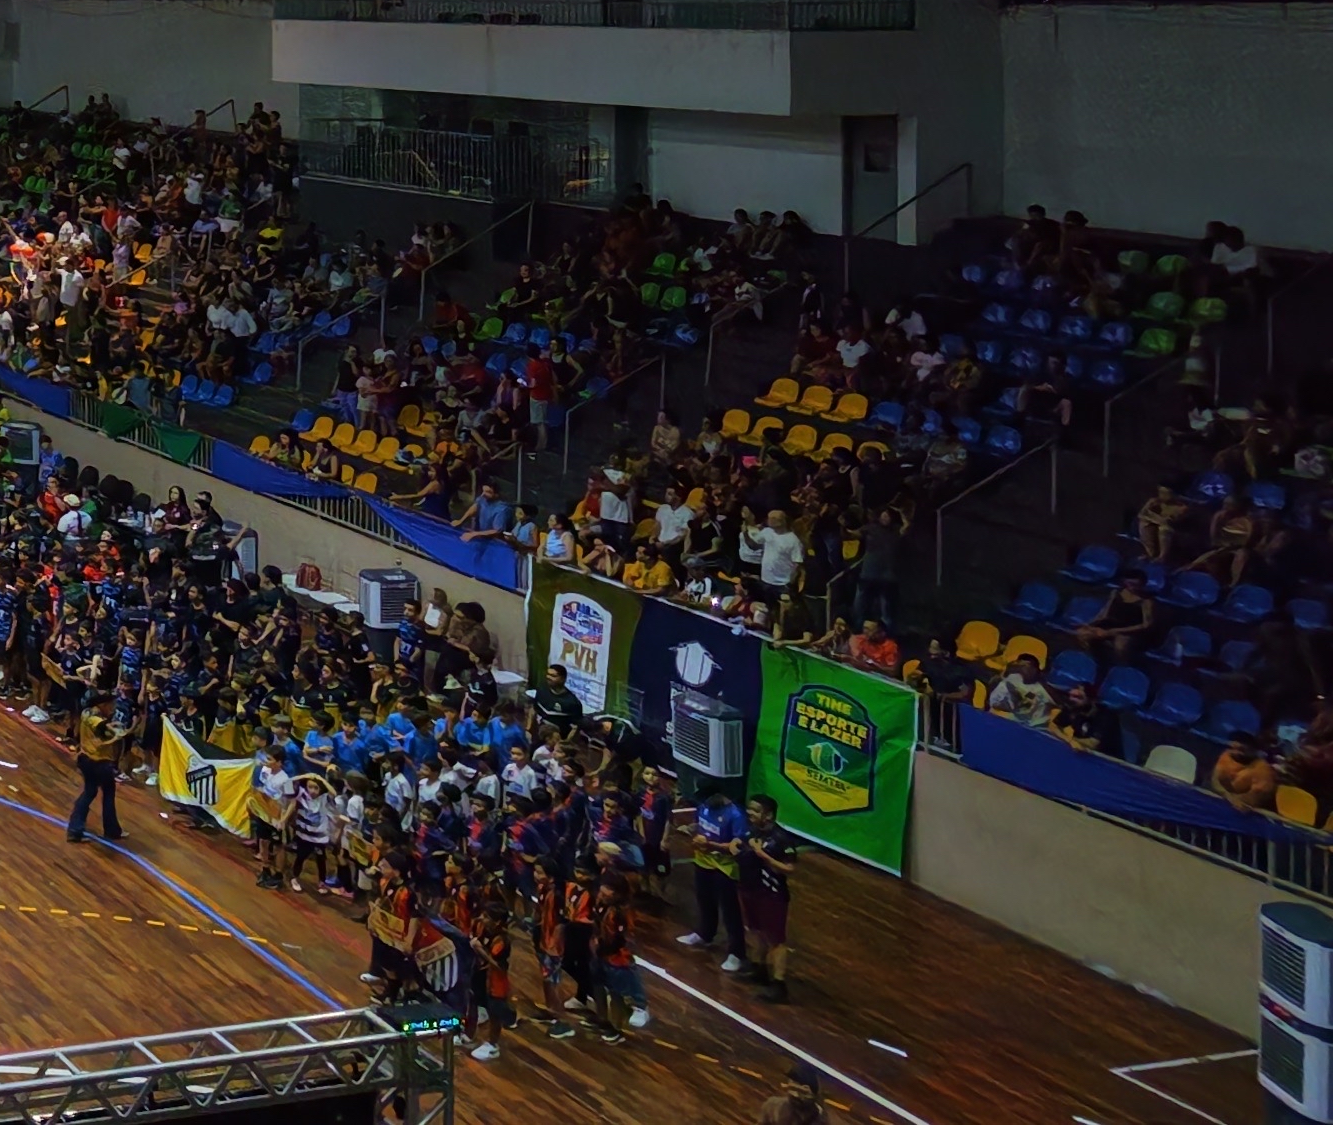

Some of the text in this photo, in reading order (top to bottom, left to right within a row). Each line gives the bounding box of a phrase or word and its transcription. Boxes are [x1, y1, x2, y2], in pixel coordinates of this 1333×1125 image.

[559, 638, 598, 676] PVH
[796, 702, 868, 739] ESPORTE
[816, 692, 852, 715] TIME
[798, 714, 862, 750] E LAZER
